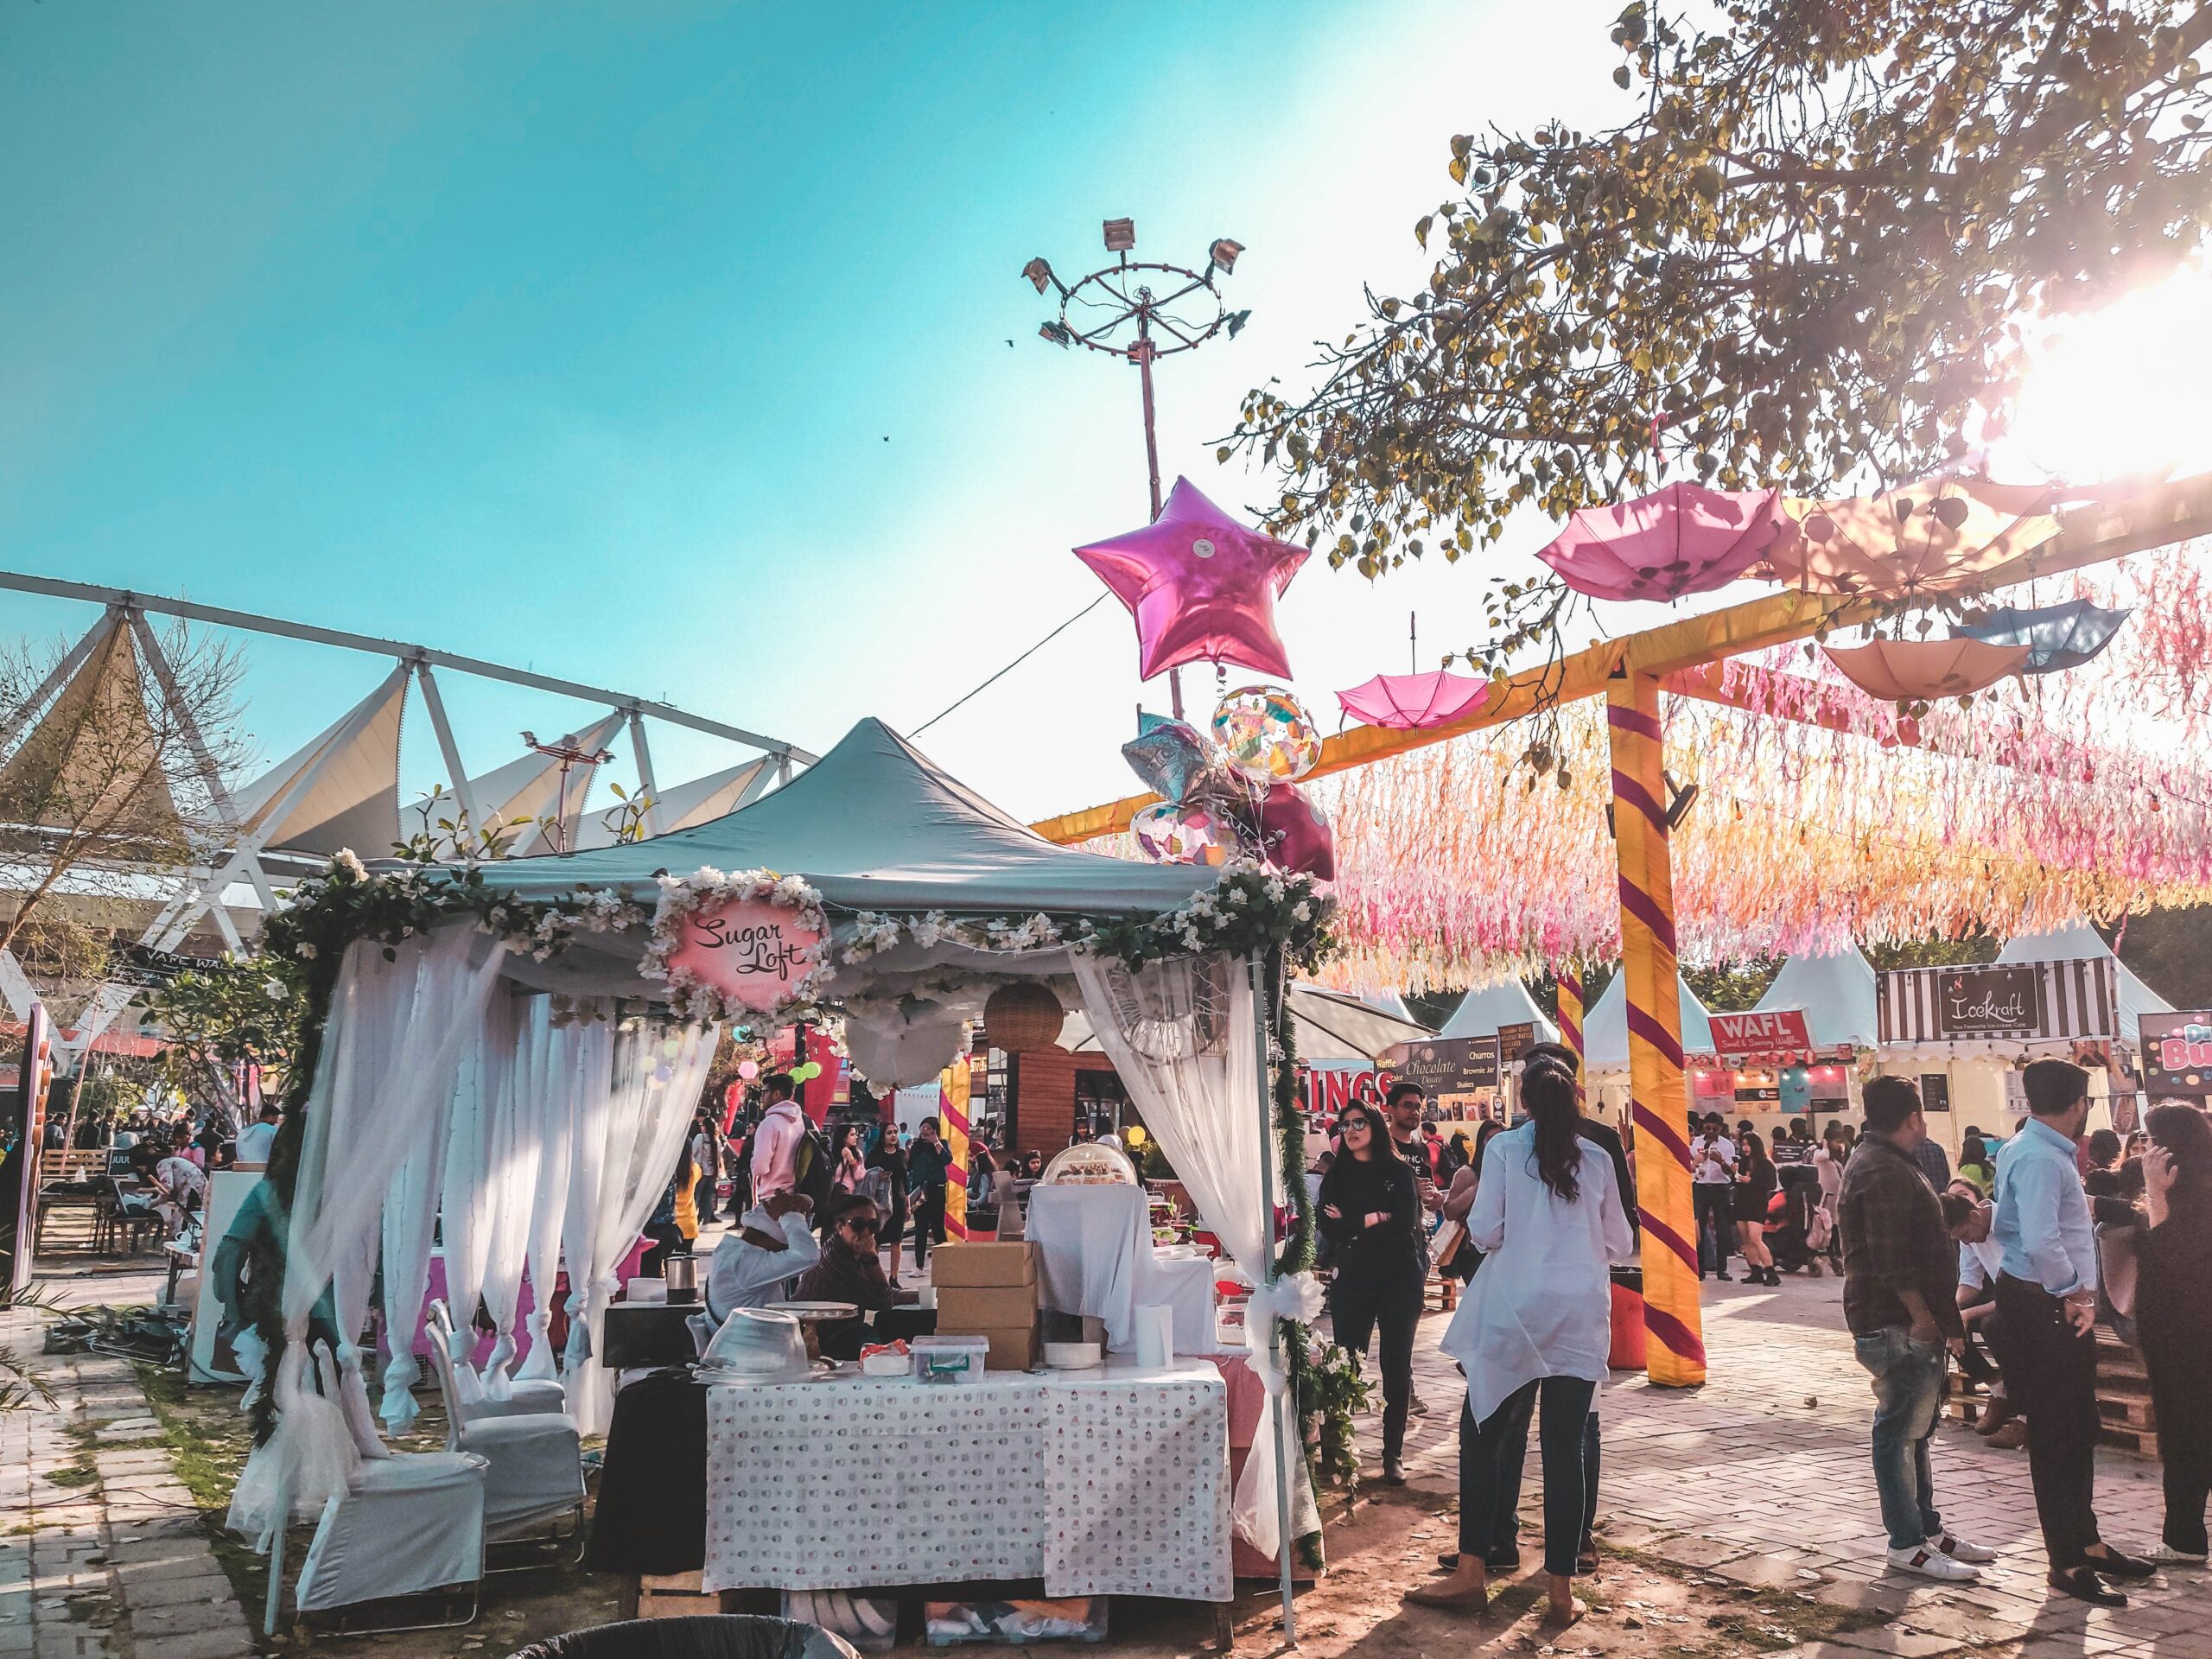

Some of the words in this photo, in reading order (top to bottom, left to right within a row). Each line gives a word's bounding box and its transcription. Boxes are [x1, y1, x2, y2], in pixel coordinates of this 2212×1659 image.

[694, 918, 784, 957] Sugar
[145, 950, 191, 966] VAPE
[736, 939, 807, 982] Loft
[1718, 1013, 1791, 1039] WAFL
[1376, 1058, 1397, 1070] Waffle
[1469, 1052, 1495, 1060] Churros
[1406, 1058, 1456, 1076] Chocolate
[1463, 1066, 1486, 1075] Brownie
[1486, 1065, 1496, 1074] Jar
